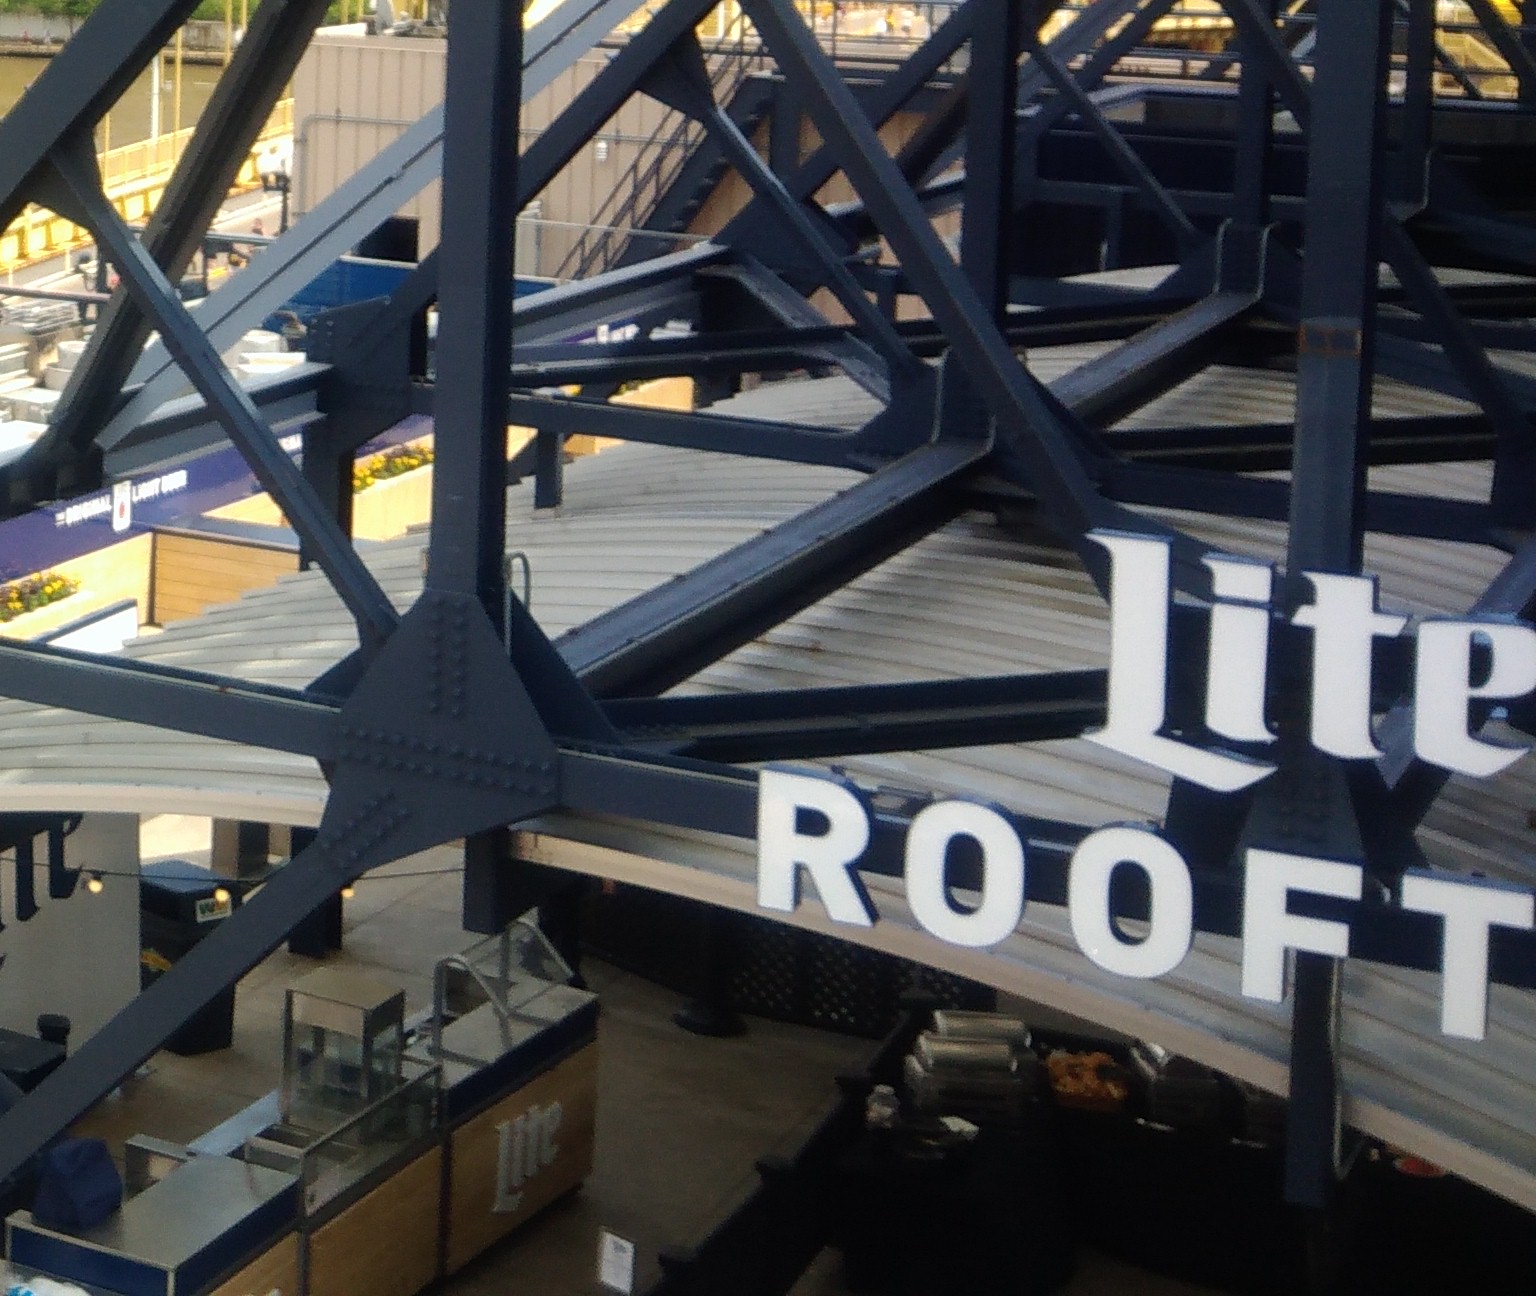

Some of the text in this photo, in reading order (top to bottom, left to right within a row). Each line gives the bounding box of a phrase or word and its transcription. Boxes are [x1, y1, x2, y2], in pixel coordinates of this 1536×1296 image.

[1081, 526, 1536, 793] Lite
[756, 767, 1536, 1041] ROOFT
[492, 1101, 563, 1213] Lite
